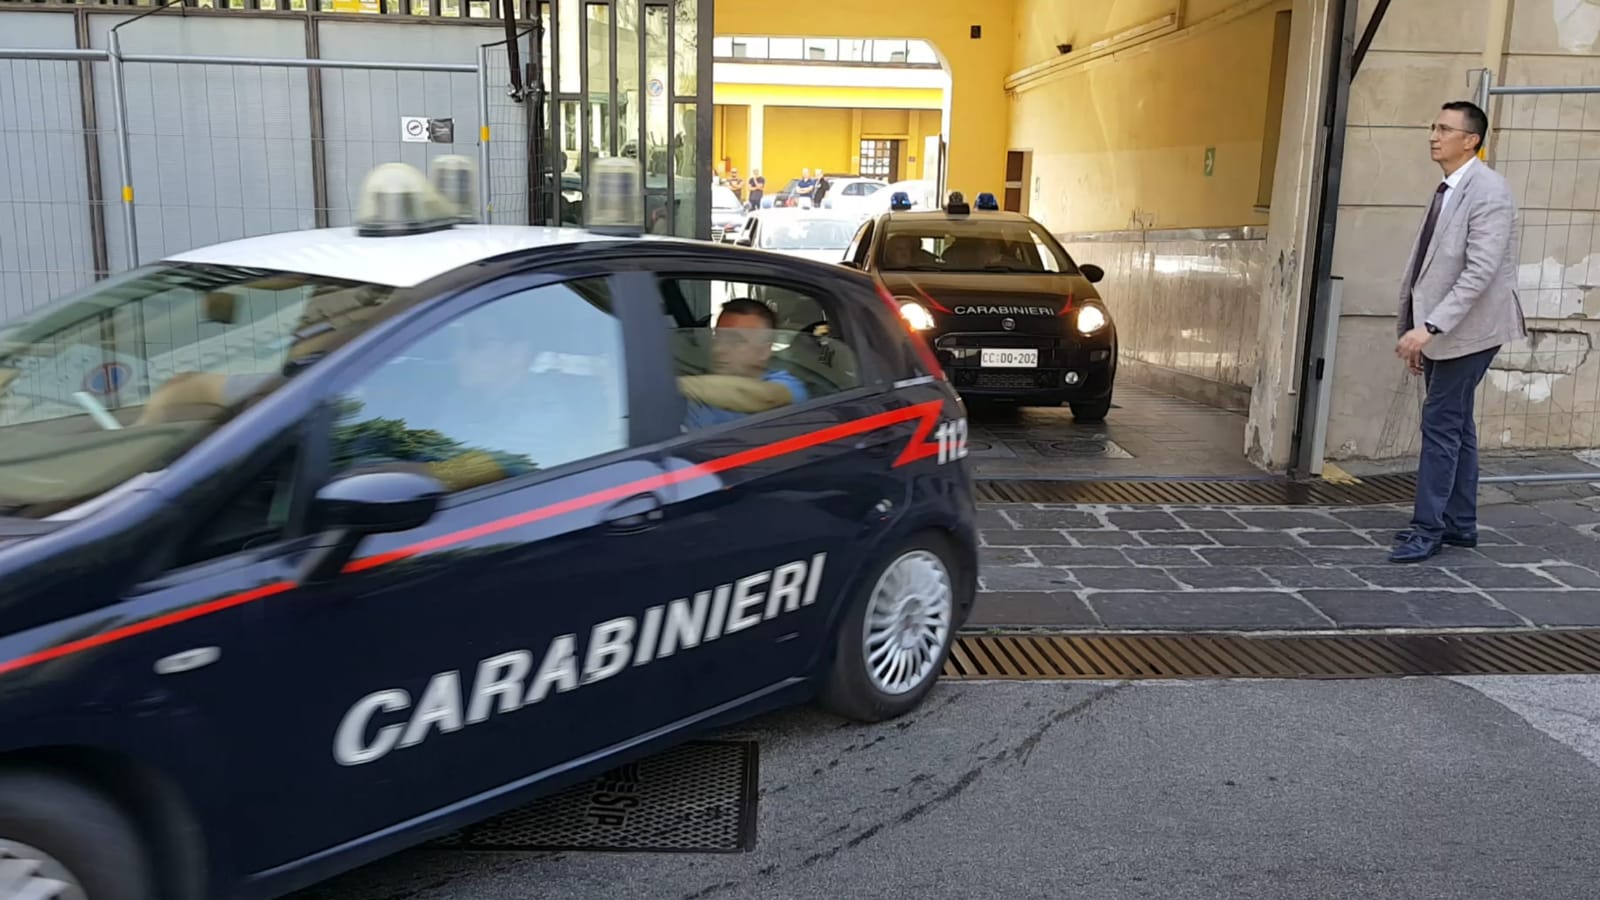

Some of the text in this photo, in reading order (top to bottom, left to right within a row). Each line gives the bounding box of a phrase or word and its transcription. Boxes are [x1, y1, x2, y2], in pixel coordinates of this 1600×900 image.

[954, 305, 1055, 316] CARABINIERI
[934, 417, 969, 465] 112
[334, 552, 826, 765] CARABINIERI
